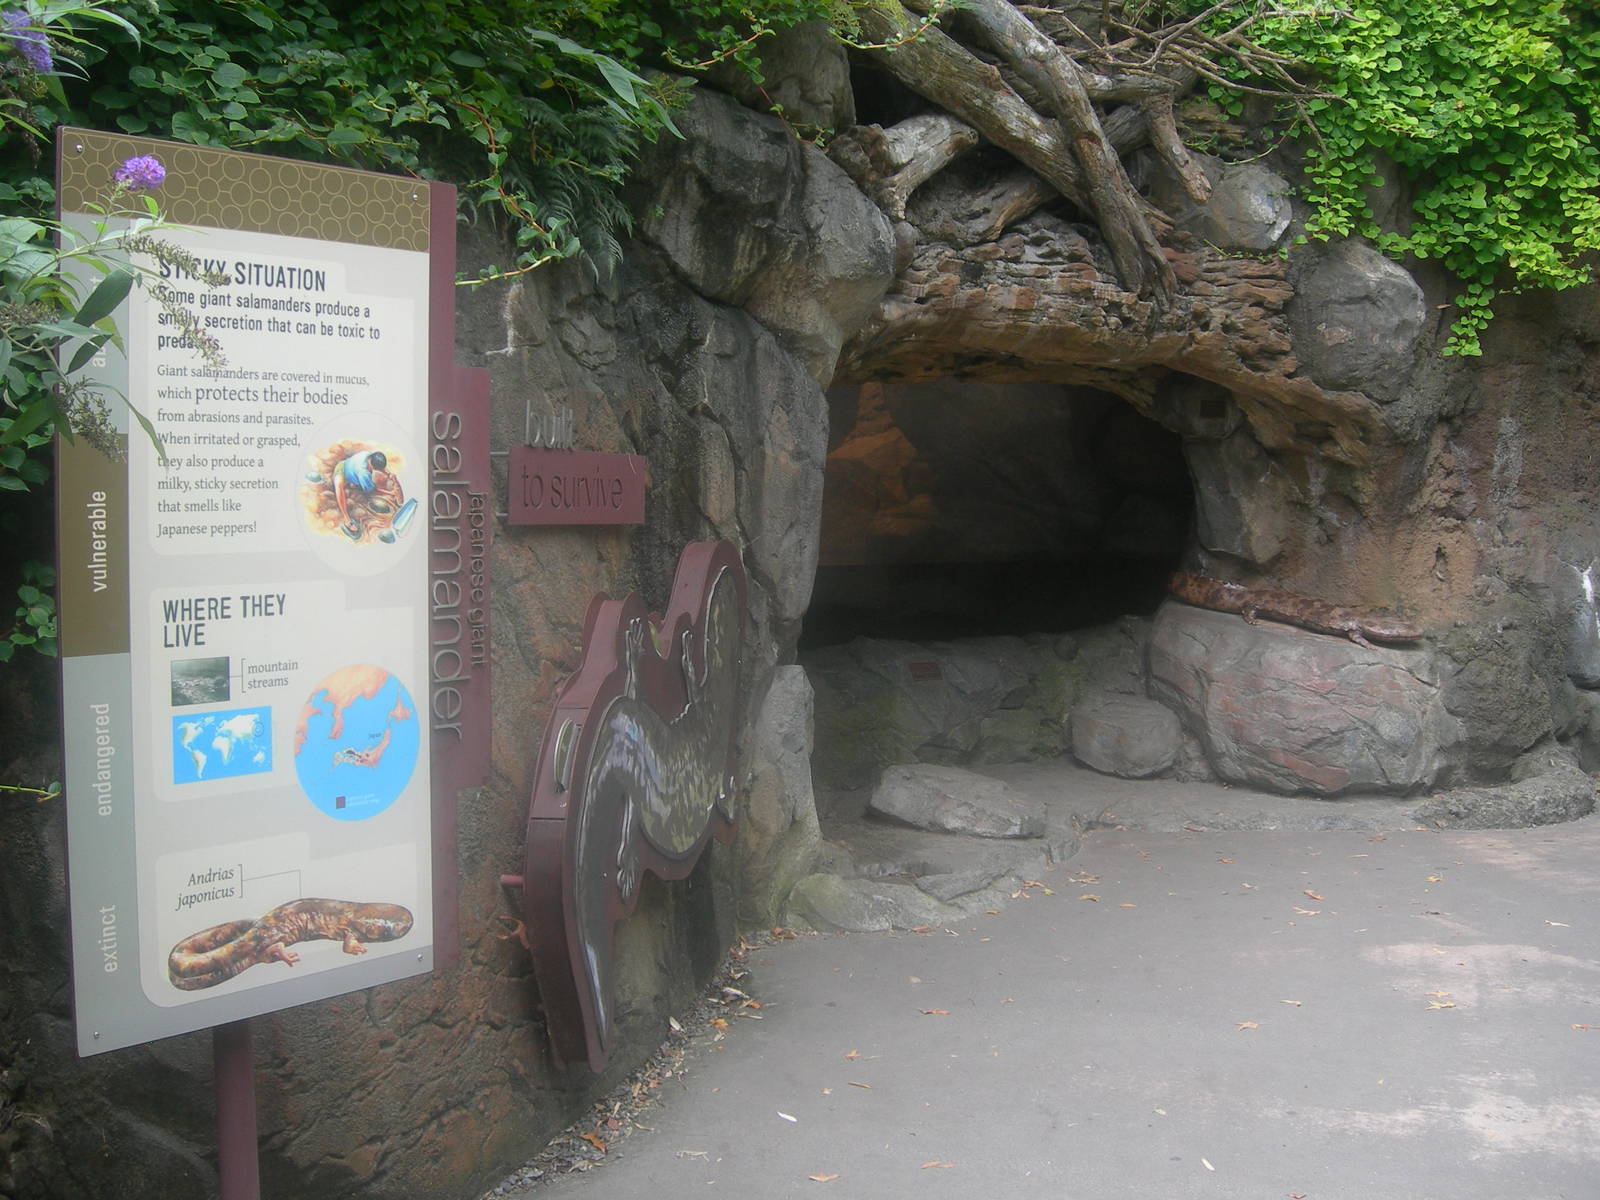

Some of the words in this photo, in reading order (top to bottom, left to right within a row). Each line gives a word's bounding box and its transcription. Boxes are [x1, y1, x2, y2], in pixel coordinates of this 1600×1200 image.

[235, 261, 326, 291] SITUATION
[158, 286, 195, 304] Some
[200, 292, 231, 308] giant
[236, 293, 311, 313] salamanders
[316, 301, 360, 317] produce
[363, 307, 370, 318] a
[204, 313, 263, 331] secretion
[268, 317, 292, 334] that
[296, 322, 316, 335] can
[320, 321, 333, 336] be
[338, 323, 365, 338] toxic
[369, 326, 381, 340] to
[157, 364, 188, 377] Giant
[191, 365, 260, 380] salamanders
[261, 371, 278, 381] are
[281, 369, 321, 383] covered
[323, 371, 333, 384] in
[335, 375, 370, 386] mucus,
[158, 386, 192, 400] which
[195, 386, 259, 405] protects
[263, 385, 300, 404] their
[303, 386, 348, 406] bodies
[158, 408, 185, 423] from
[188, 409, 241, 424] abrasions
[243, 410, 263, 425] and
[266, 412, 314, 427] parasites.
[157, 432, 191, 445] When
[194, 432, 240, 446] irritated
[242, 436, 254, 446] or
[257, 434, 301, 449] grasped,
[186, 454, 208, 467] also
[211, 454, 256, 470] produce
[258, 458, 264, 467] a
[158, 477, 192, 492] milky,
[194, 476, 227, 493] sticky
[230, 478, 279, 490] secretion
[521, 464, 544, 509] to
[549, 466, 624, 511] survive
[158, 500, 181, 512] that
[184, 499, 220, 512] smells
[222, 499, 242, 511] like
[87, 490, 107, 592] vulnerable
[157, 523, 208, 538] Japanese
[210, 521, 257, 537] peppers!
[432, 410, 471, 741] salamander
[163, 597, 231, 623] WHERE
[240, 594, 286, 618] THEY
[164, 623, 206, 648] LIVE
[467, 607, 488, 666] giant
[248, 660, 298, 674] mountain
[248, 676, 289, 689] streams
[90, 703, 115, 816] endangered
[187, 866, 235, 886] Andrias
[175, 886, 235, 911] japonicus
[98, 904, 117, 973] extinct
